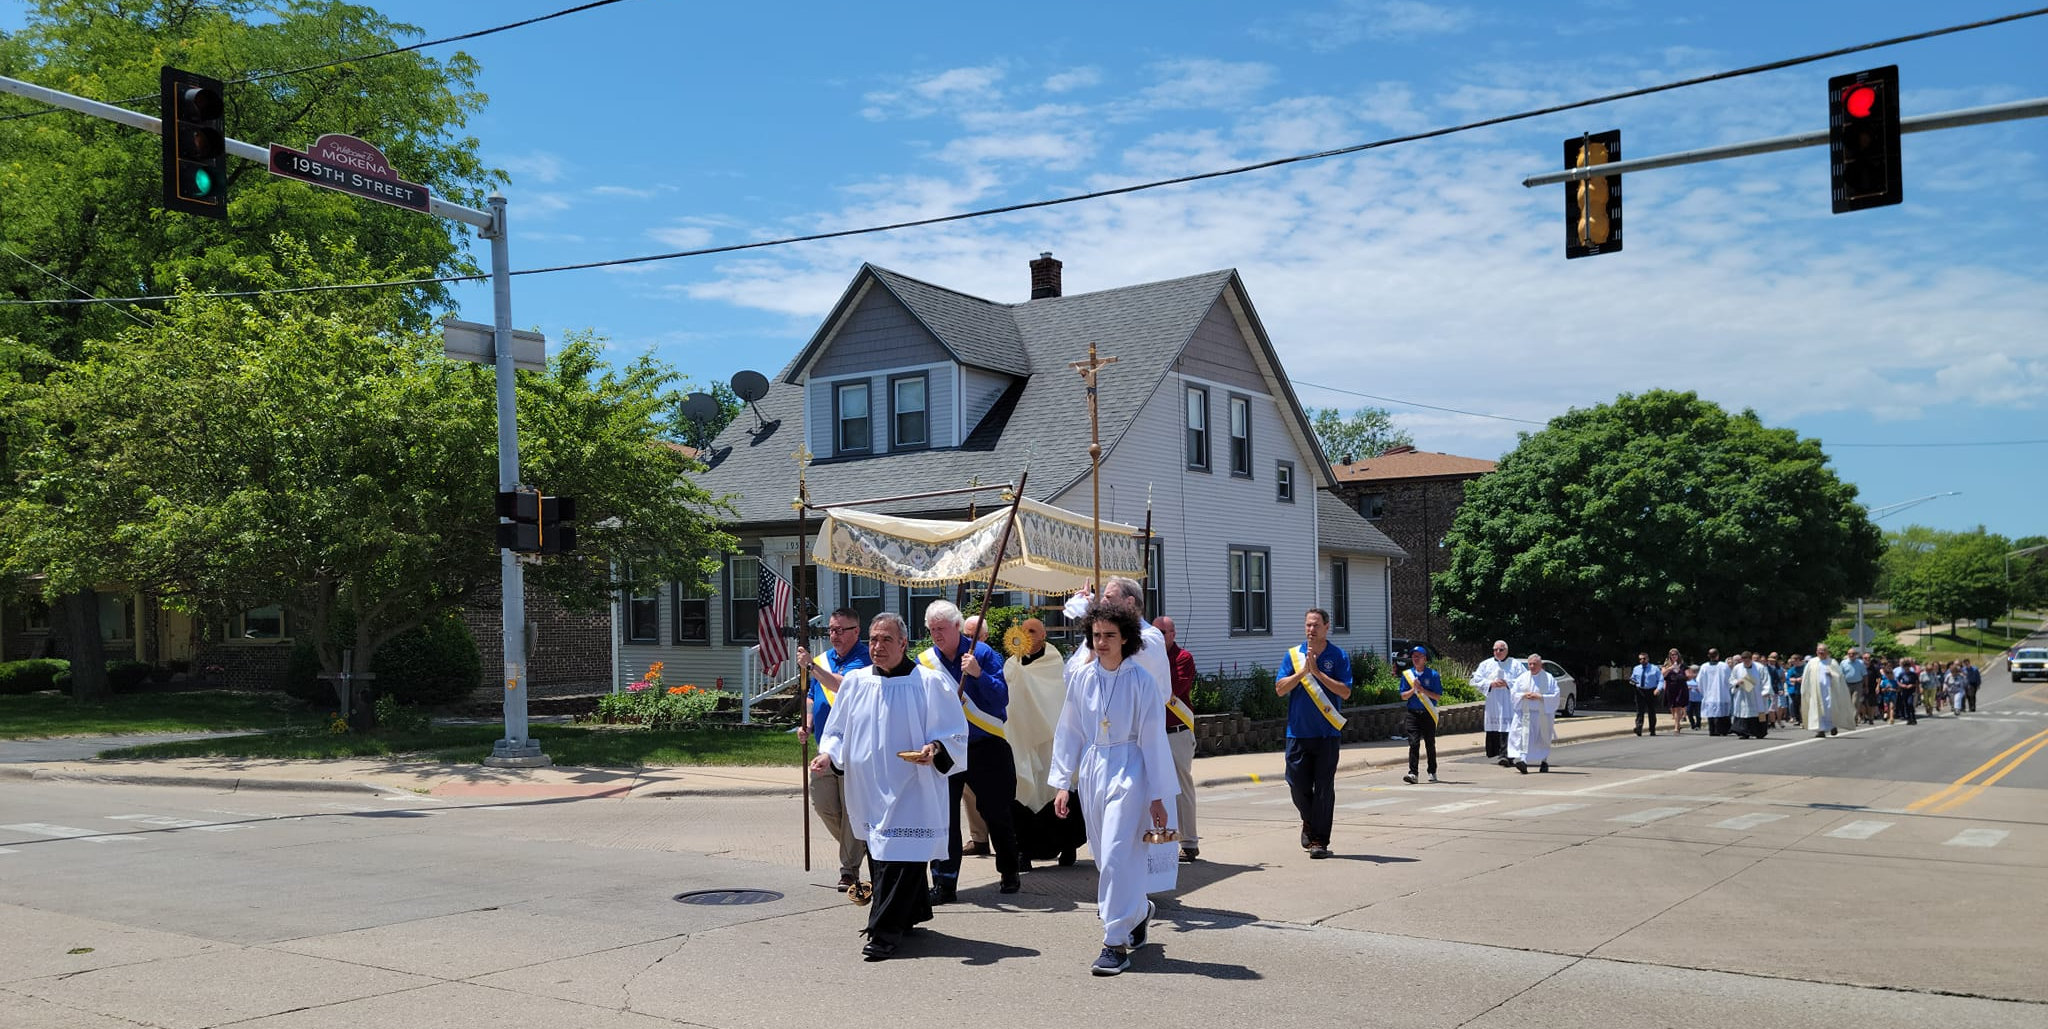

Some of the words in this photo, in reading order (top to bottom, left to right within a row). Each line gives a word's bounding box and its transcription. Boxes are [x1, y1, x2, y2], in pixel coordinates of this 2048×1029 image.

[322, 149, 387, 175] MOKENA
[292, 156, 345, 183] 195TH
[352, 174, 413, 200] STREET
[786, 541, 810, 550] 1952
